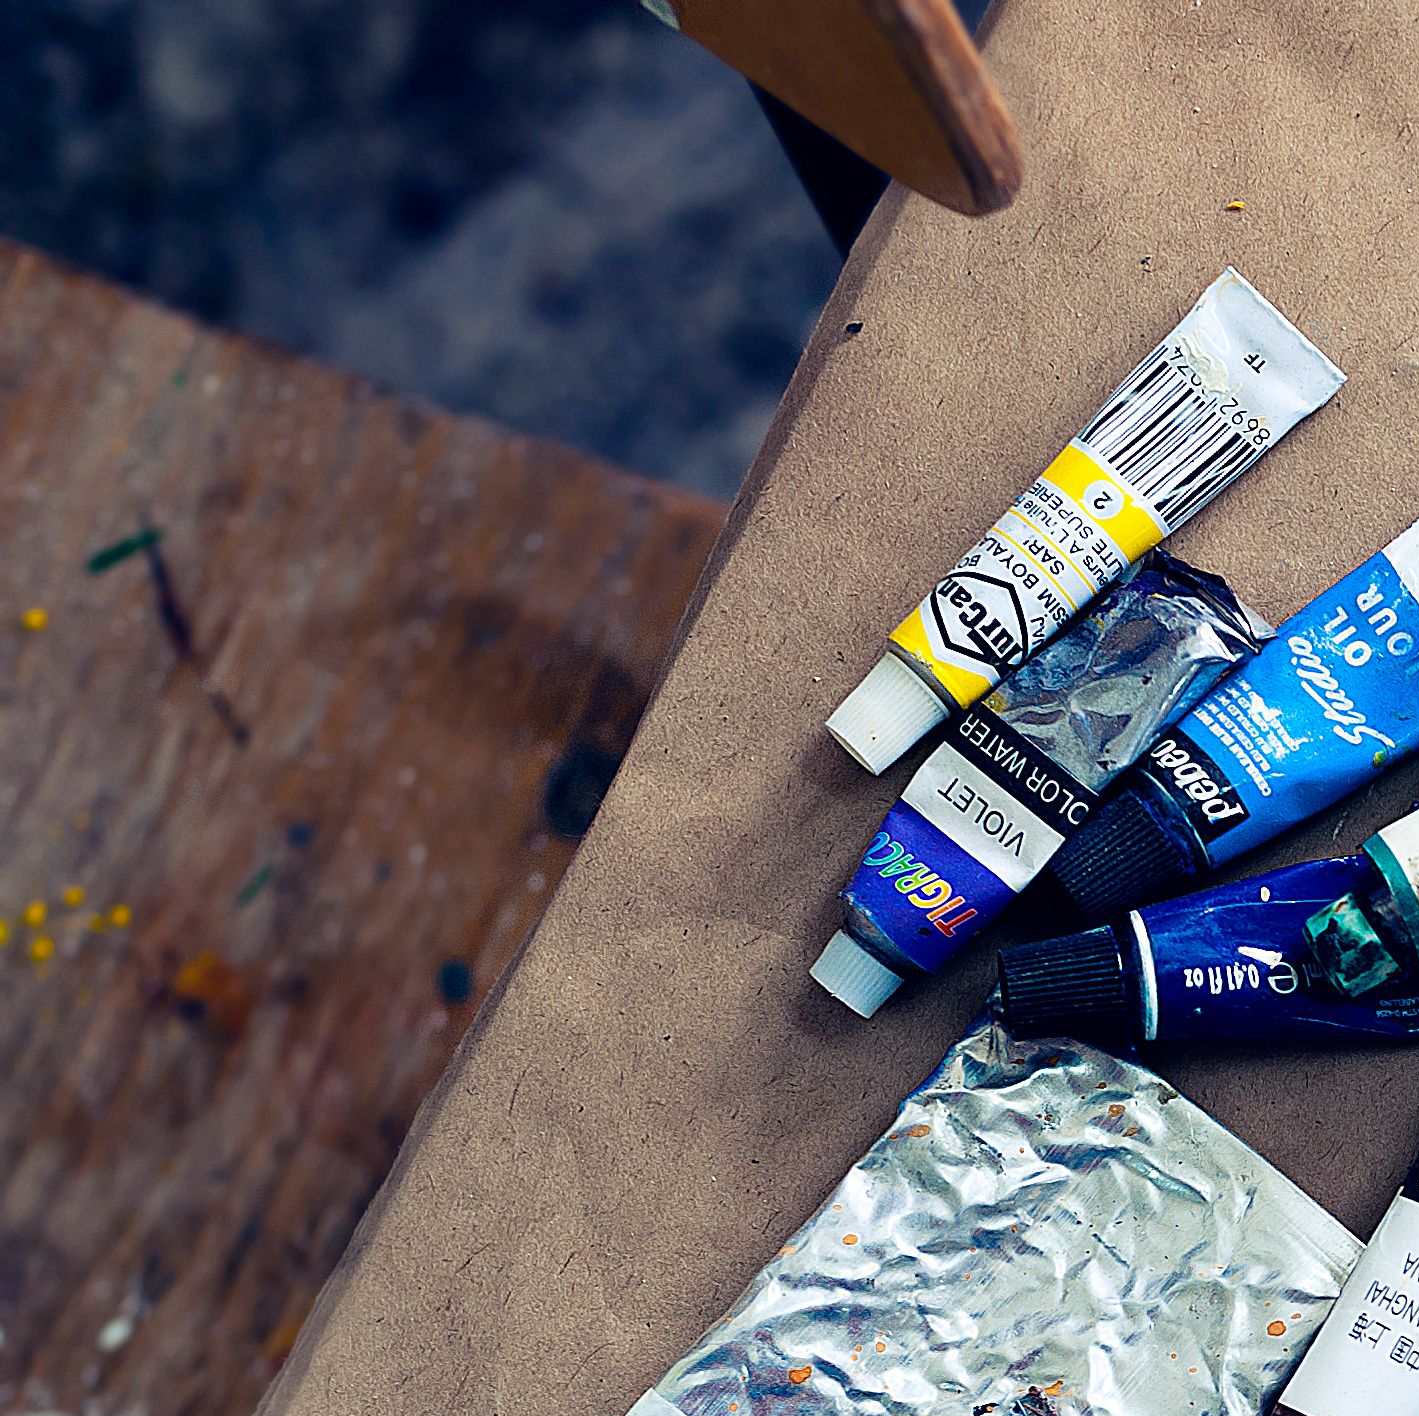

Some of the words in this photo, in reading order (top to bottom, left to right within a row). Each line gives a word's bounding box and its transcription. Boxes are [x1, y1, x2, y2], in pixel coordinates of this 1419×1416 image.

[1244, 355, 1265, 373] TF
[1220, 397, 1270, 445] 8692
[1091, 489, 1113, 511] 2
[1068, 539, 1084, 555] A
[1330, 607, 1370, 666] OIL
[1288, 636, 1395, 747] Studio
[960, 714, 1026, 778] WATER
[938, 778, 1024, 856] VIOLET
[1184, 968, 1203, 987] oz
[1226, 963, 1259, 990] 0.41
[1349, 1313, 1391, 1344] 上海
